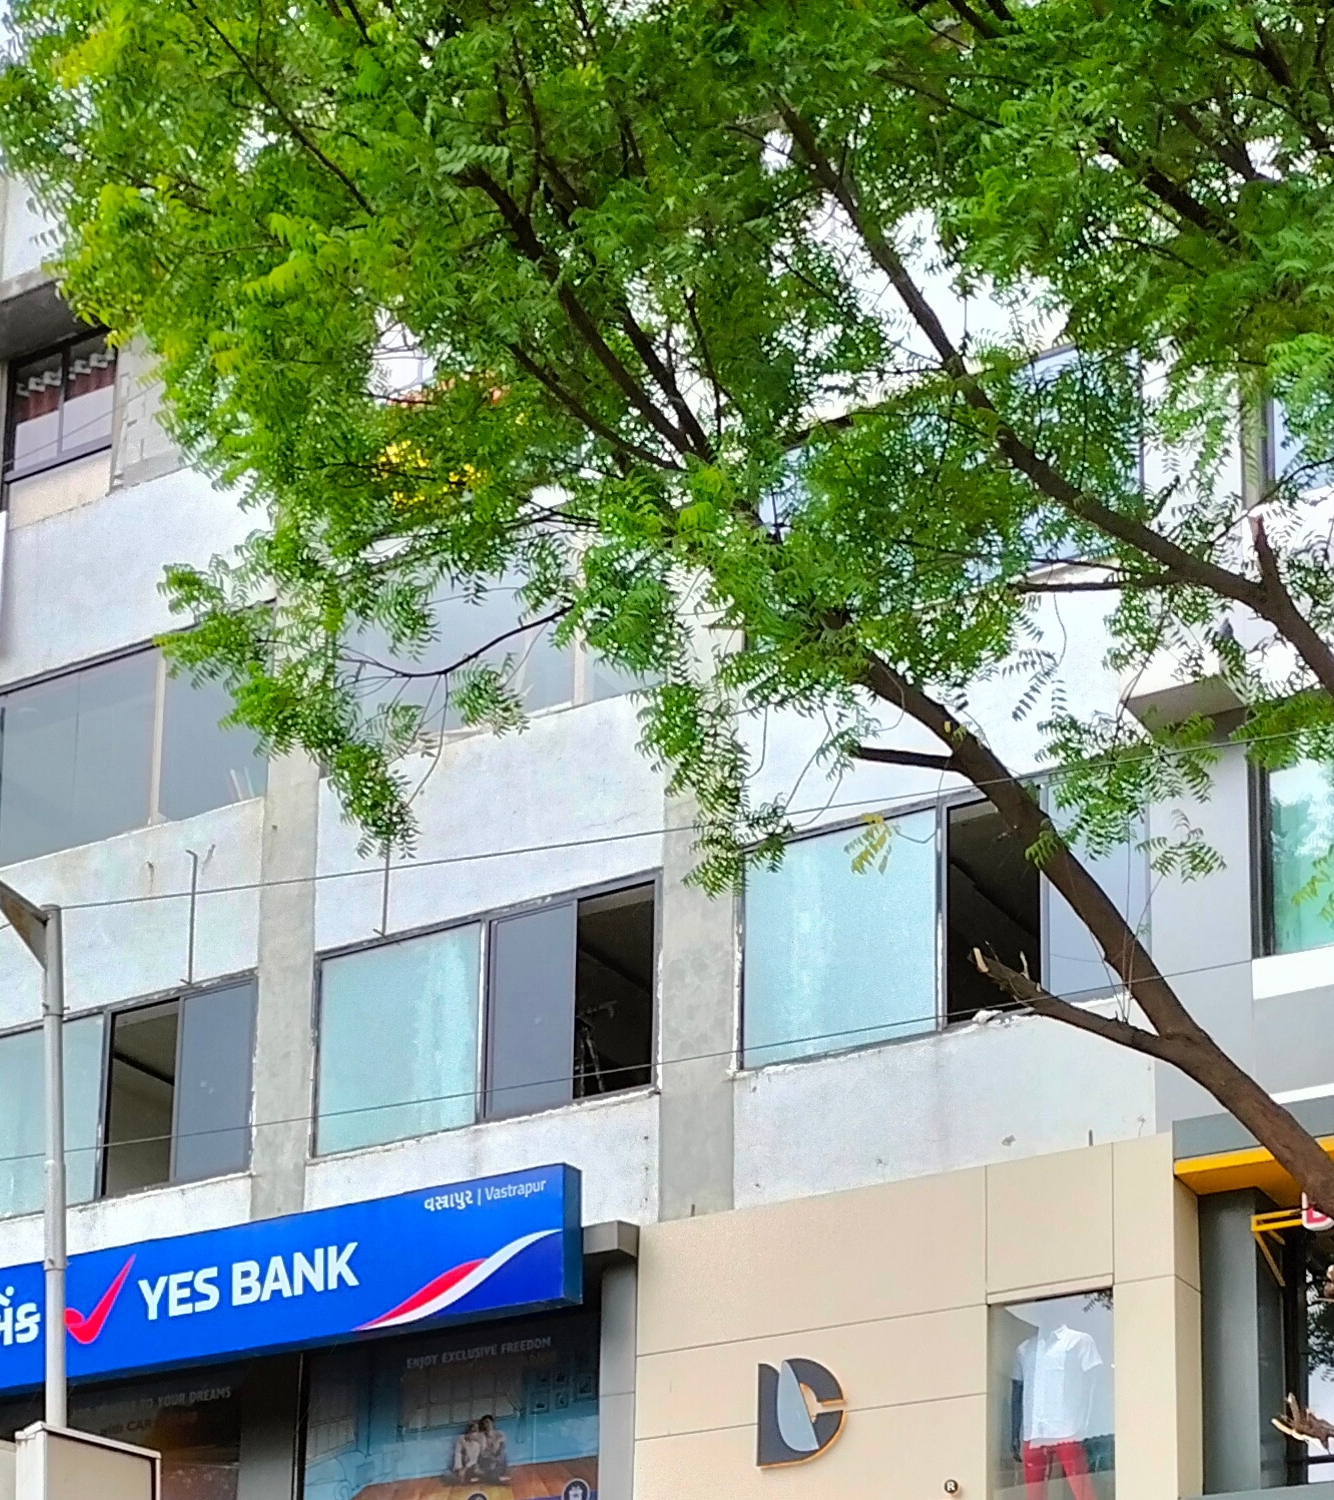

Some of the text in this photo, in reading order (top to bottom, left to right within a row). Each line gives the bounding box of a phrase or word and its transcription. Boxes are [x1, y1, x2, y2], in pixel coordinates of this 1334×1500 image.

[484, 1180, 547, 1200] Vastrapur
[137, 1241, 361, 1320] YES BANK
[406, 1336, 552, 1370] ENJOY EXCLUSIVE FREEDOM
[188, 1385, 232, 1405] DREAMS
